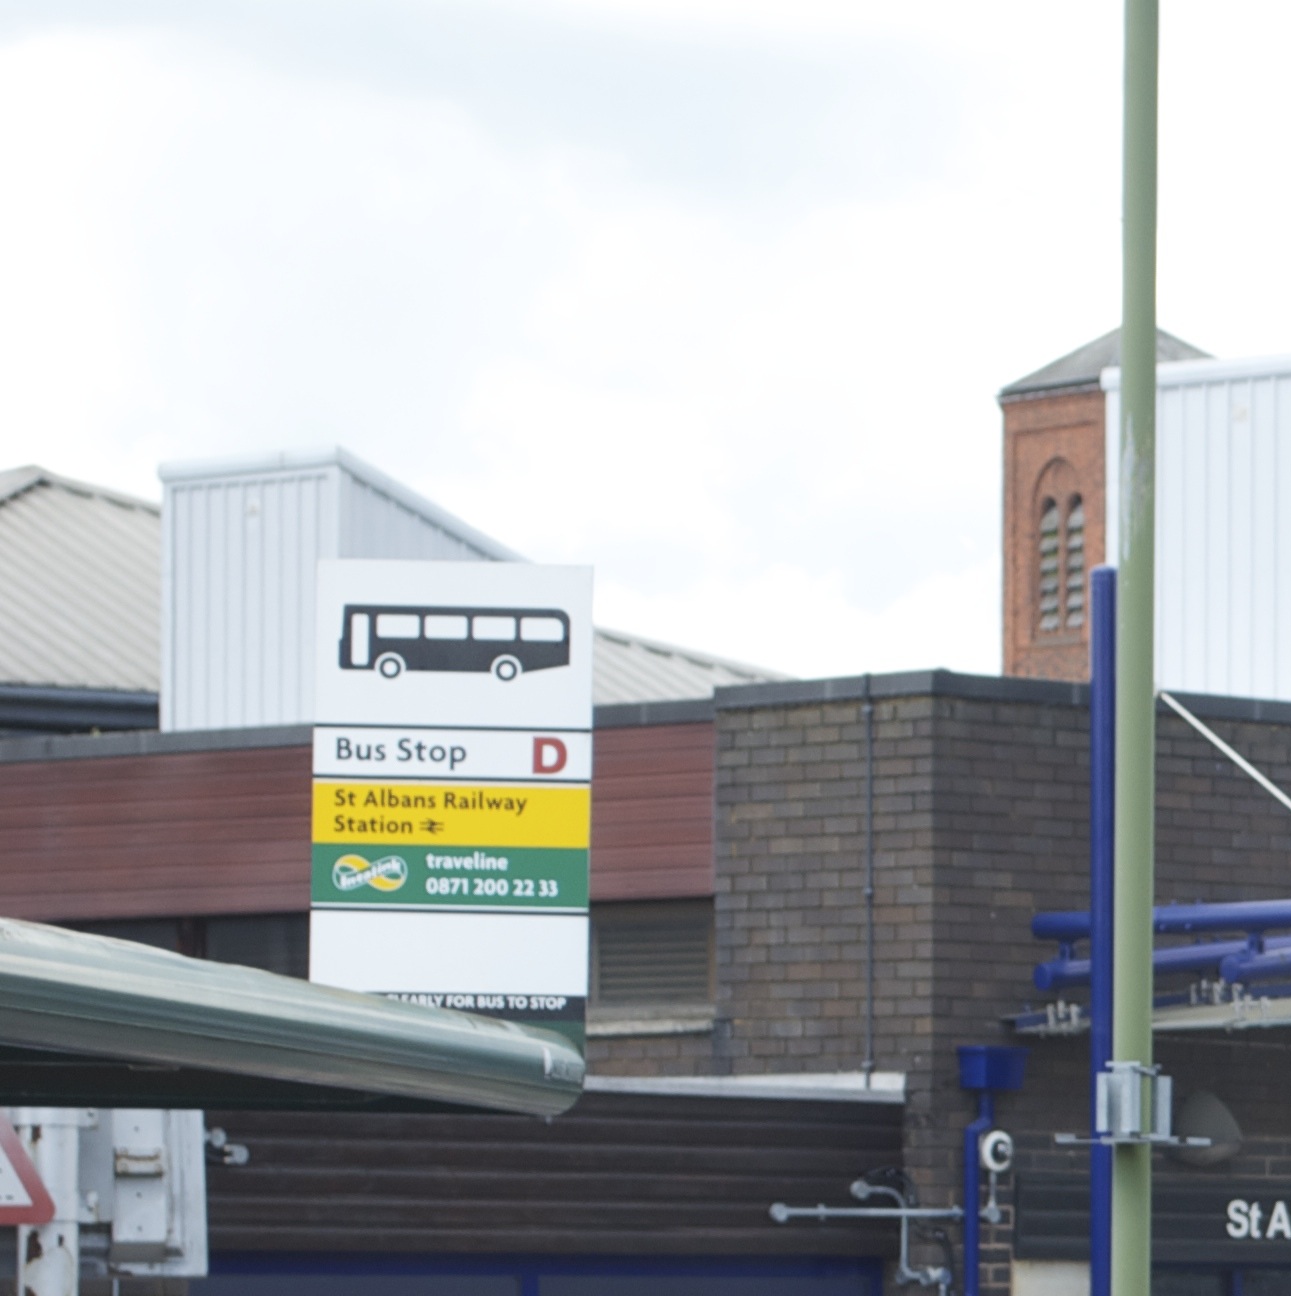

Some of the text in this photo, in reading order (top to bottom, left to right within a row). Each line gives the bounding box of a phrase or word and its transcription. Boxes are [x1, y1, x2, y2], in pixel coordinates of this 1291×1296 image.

[336, 736, 568, 774] Bus Stop D
[334, 788, 528, 816] St Albans Railway
[333, 814, 414, 834] Station
[425, 851, 508, 870] traveline
[425, 876, 559, 898] 0871 200 22 33
[446, 994, 475, 1008] FOR
[477, 994, 505, 1009] BUS
[508, 996, 528, 1010] TO
[530, 997, 567, 1011] STOP
[1226, 1199, 1262, 1239] St
